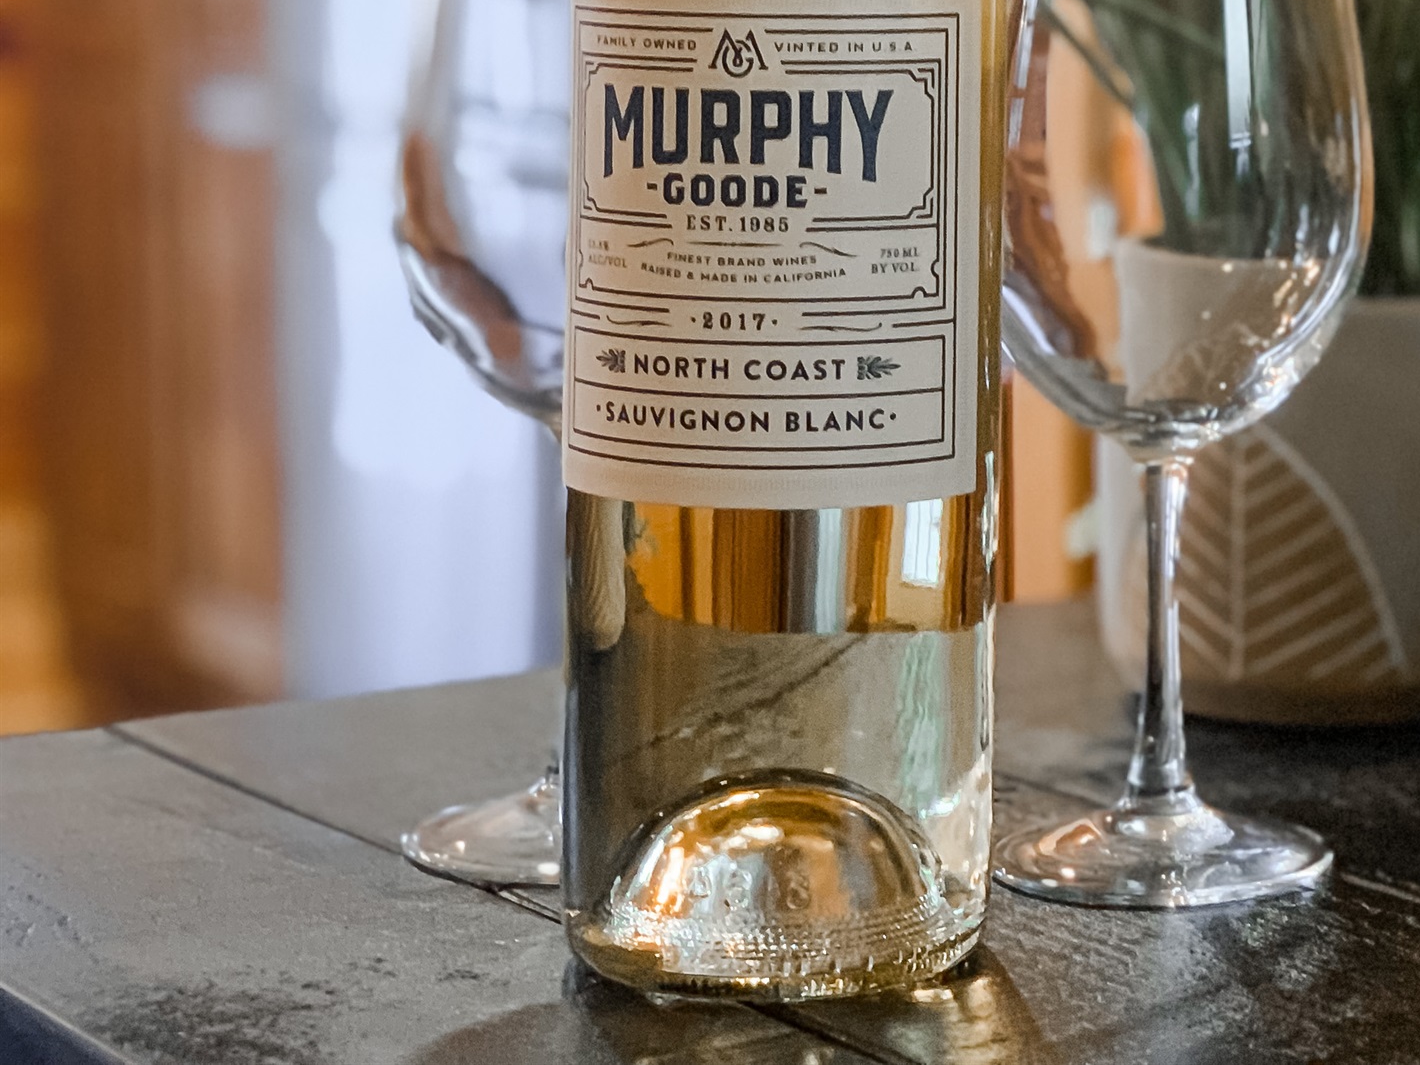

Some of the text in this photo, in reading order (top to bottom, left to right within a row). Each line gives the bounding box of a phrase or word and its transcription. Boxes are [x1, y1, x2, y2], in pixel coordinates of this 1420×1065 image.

[596, 35, 697, 51] FAMILY OWNED
[774, 41, 839, 53] VINTED
[848, 41, 864, 53] IN
[603, 83, 894, 183] MURPHY
[667, 251, 817, 267] FINEST BRAND WINES
[880, 248, 900, 259] 750
[641, 262, 847, 284] RAISED & MADE IN CALIFORNIA
[871, 263, 887, 275] BY
[634, 353, 846, 381] NORTH COAST
